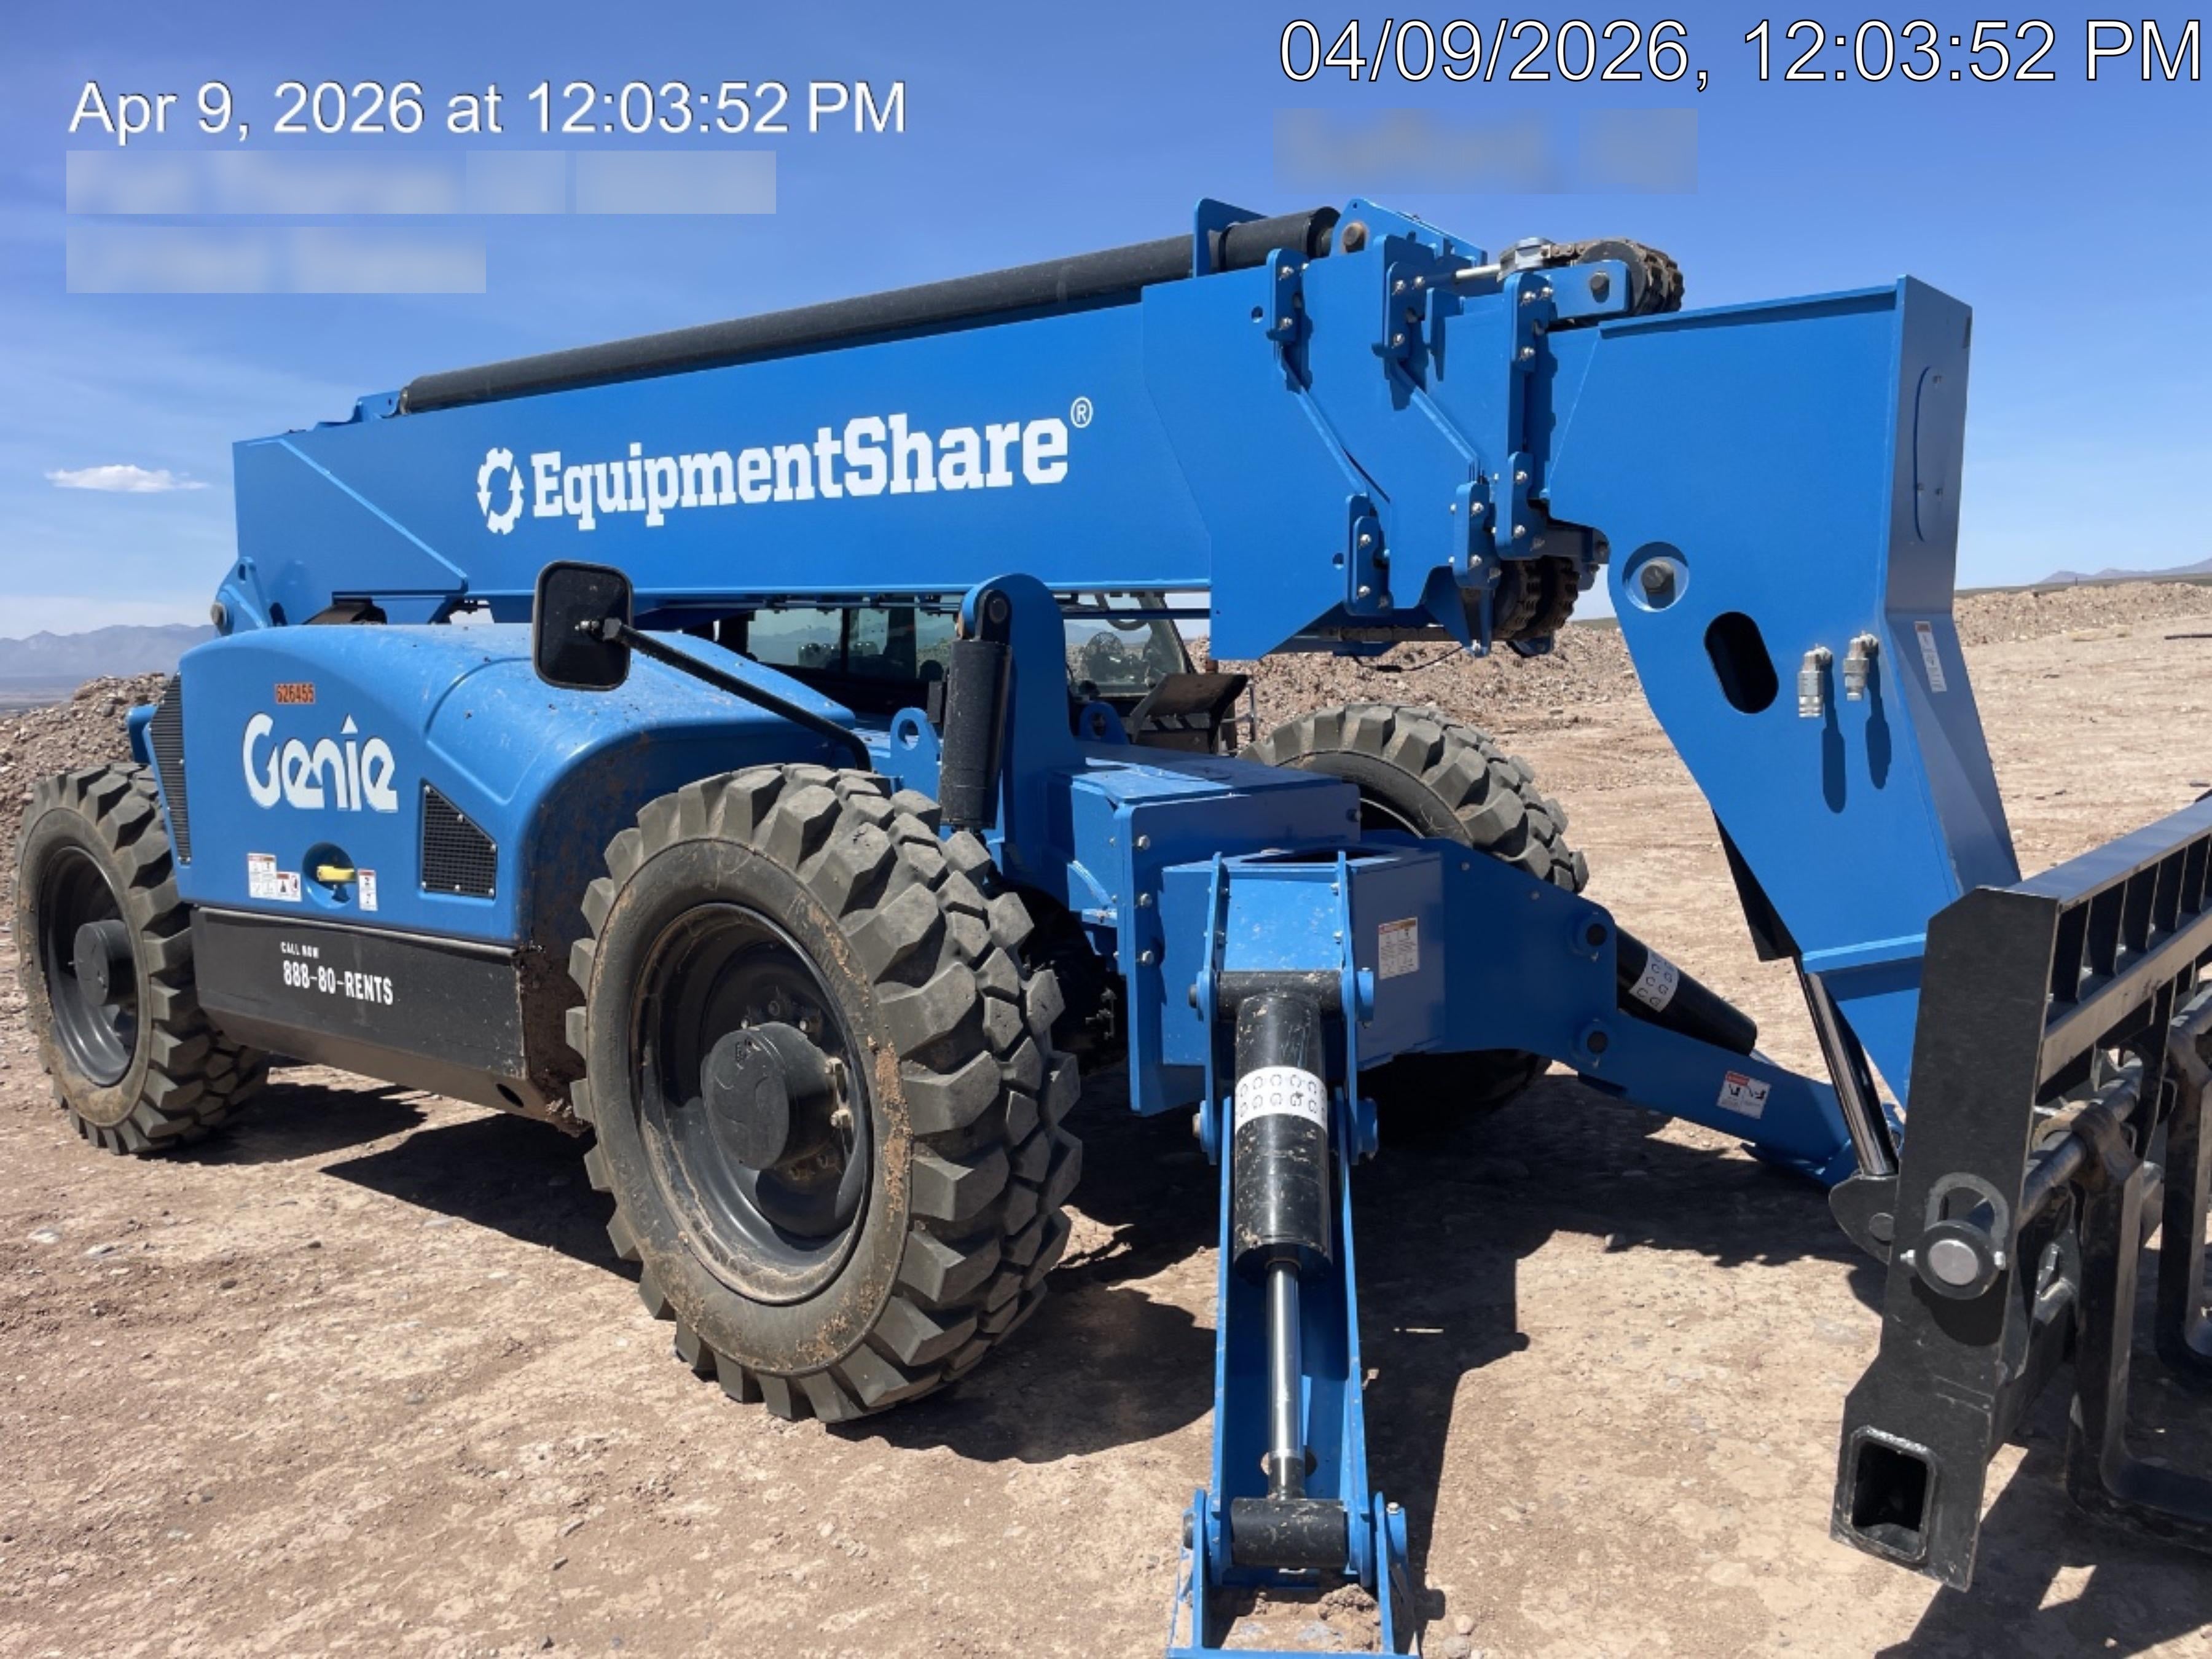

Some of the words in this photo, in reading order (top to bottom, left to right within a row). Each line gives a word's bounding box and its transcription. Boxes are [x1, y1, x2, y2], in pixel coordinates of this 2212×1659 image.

[243, 713, 399, 812] Genie
[280, 941, 300, 955] CALL
[283, 959, 394, 1005] 888-80-RENTS
